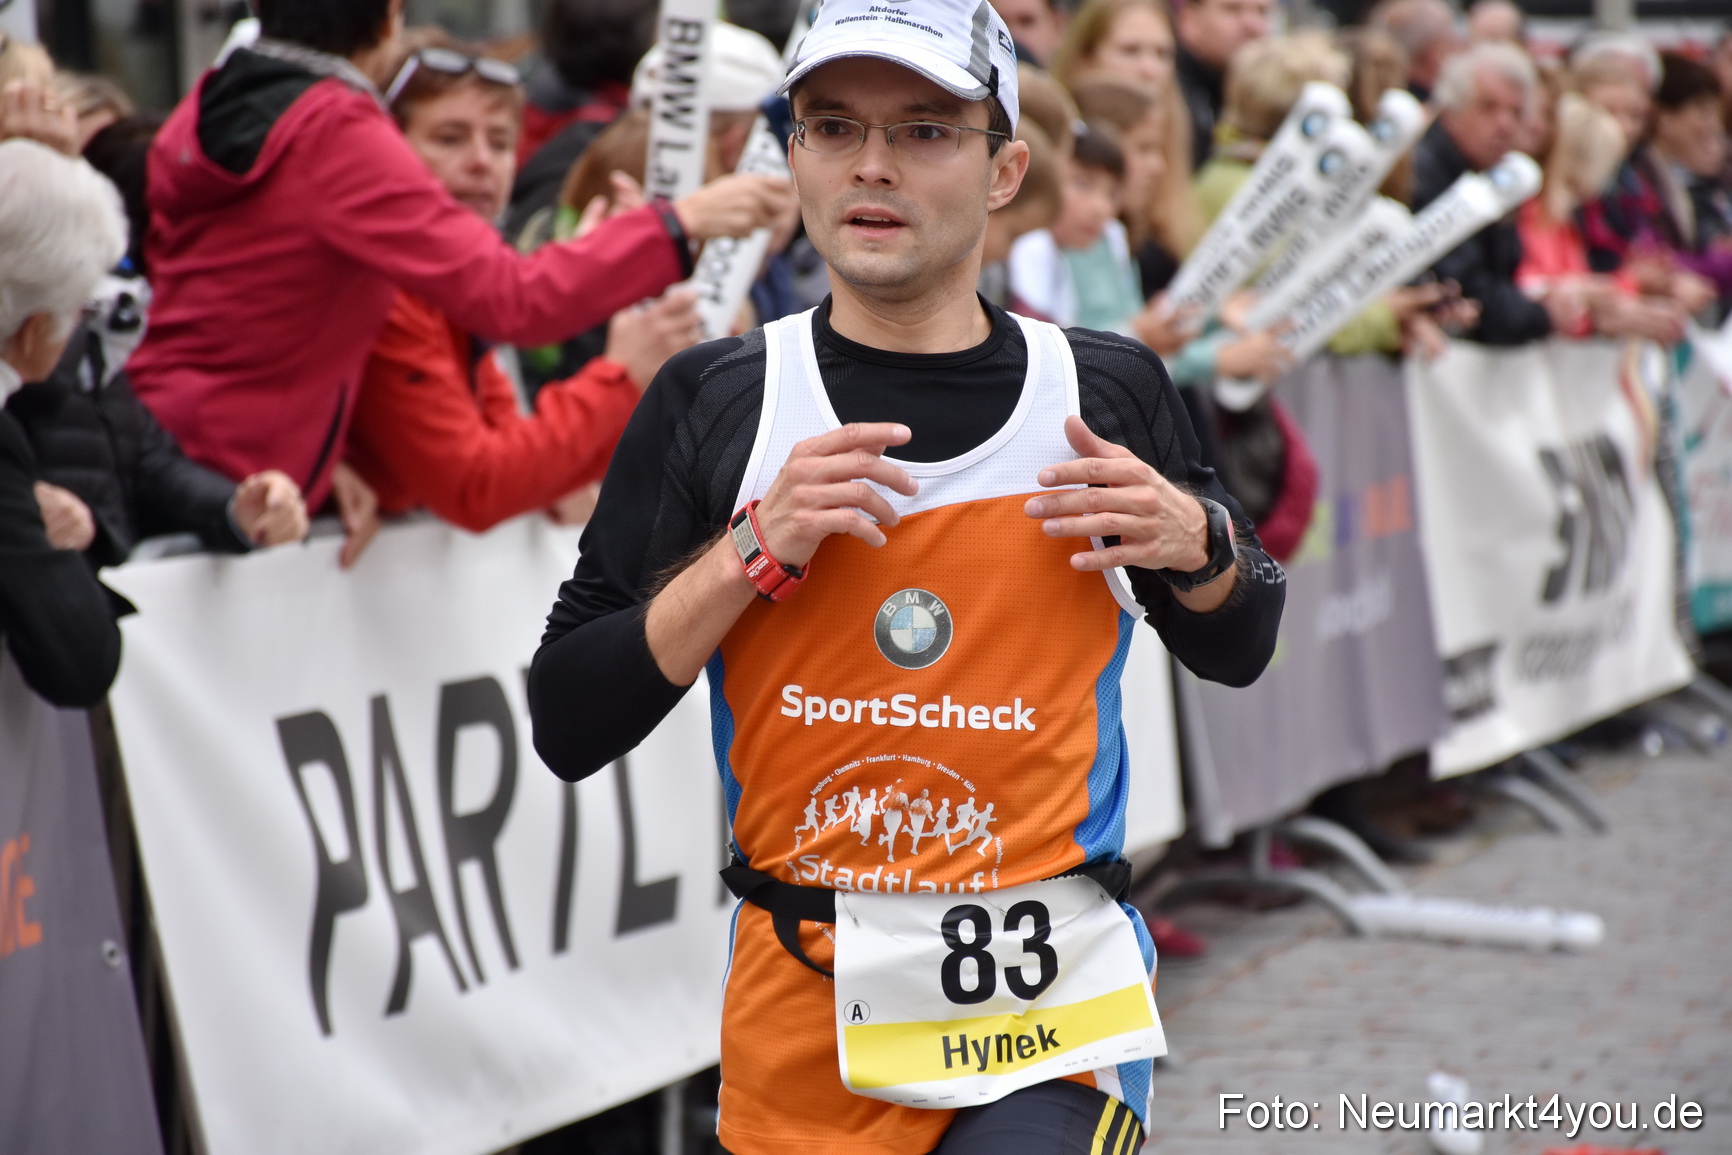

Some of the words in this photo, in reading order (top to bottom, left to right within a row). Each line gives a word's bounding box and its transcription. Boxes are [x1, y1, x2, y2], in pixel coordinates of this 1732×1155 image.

[835, 14, 878, 26] Wallenstein
[884, 15, 944, 39] Halbmarathon
[868, 5, 909, 17] Altdorfer
[658, 16, 704, 131] BMW
[882, 591, 945, 617] BMW
[781, 684, 1037, 731] SportScheck
[834, 760, 861, 775] Chemnitz
[866, 754, 896, 763] Frankfurt
[902, 754, 932, 768] Hamburg
[936, 763, 961, 780] Dresden
[962, 779, 977, 793] Köln
[940, 899, 1059, 1005] 83
[851, 1003, 864, 1022] A
[941, 1023, 1061, 1073] Hynek
